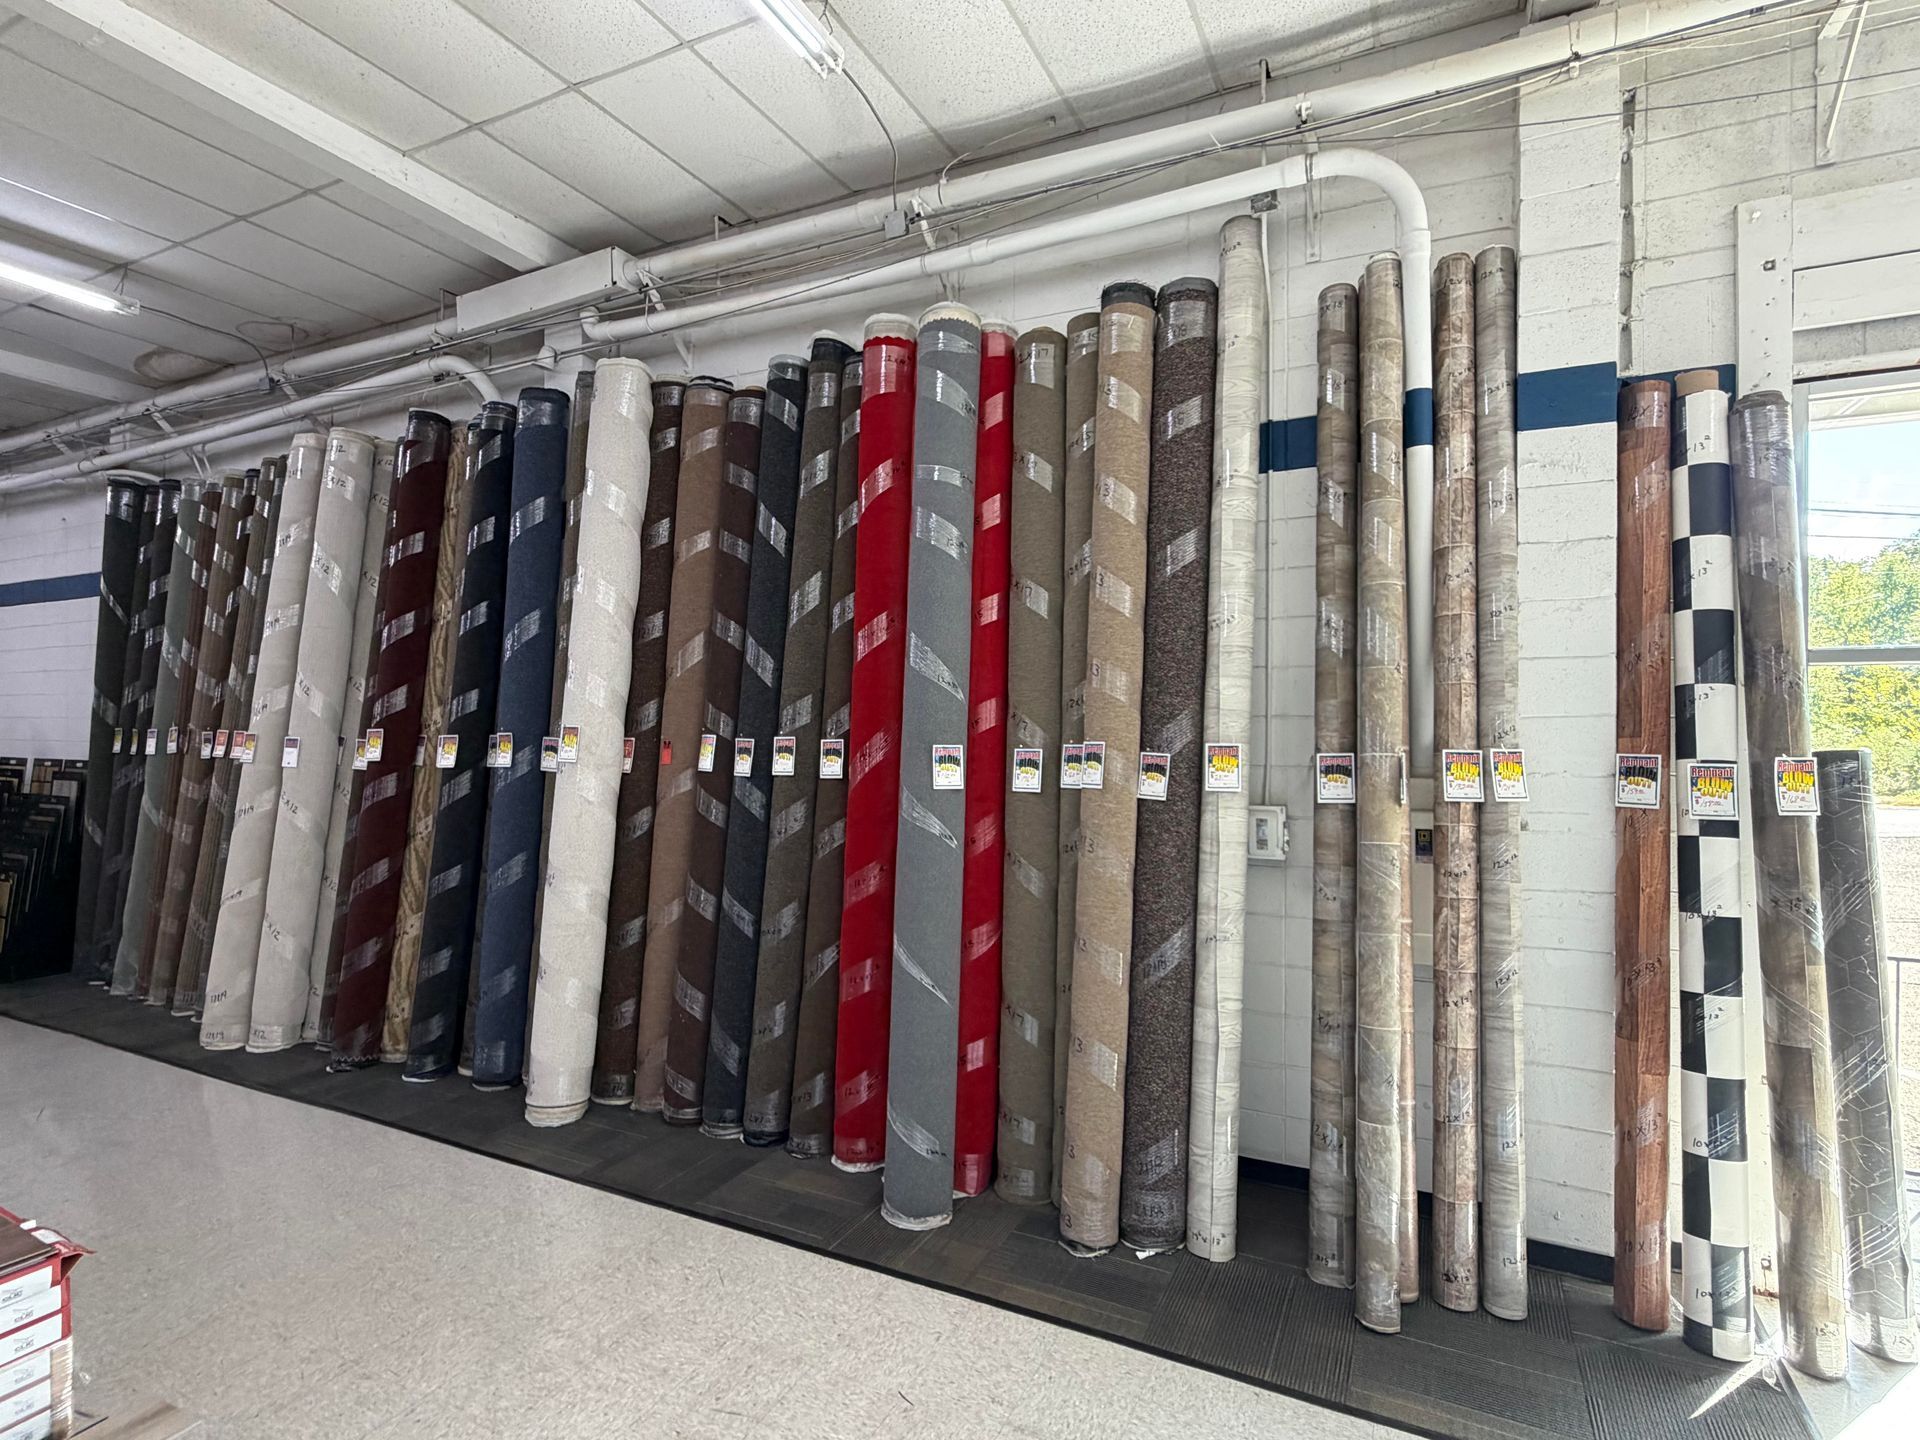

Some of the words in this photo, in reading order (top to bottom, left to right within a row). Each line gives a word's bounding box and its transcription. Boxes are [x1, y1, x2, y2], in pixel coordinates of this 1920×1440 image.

[1446, 754, 1479, 762] Remnant
[1493, 753, 1522, 762] Remnant
[1620, 758, 1657, 767] Remnant
[1450, 762, 1479, 776] BLOW
[1498, 762, 1522, 775] BLOW
[1778, 760, 1814, 771] Remnant
[1692, 768, 1734, 777] Remnant
[1782, 771, 1813, 784] BLOW
[1698, 777, 1733, 789] BLOW
